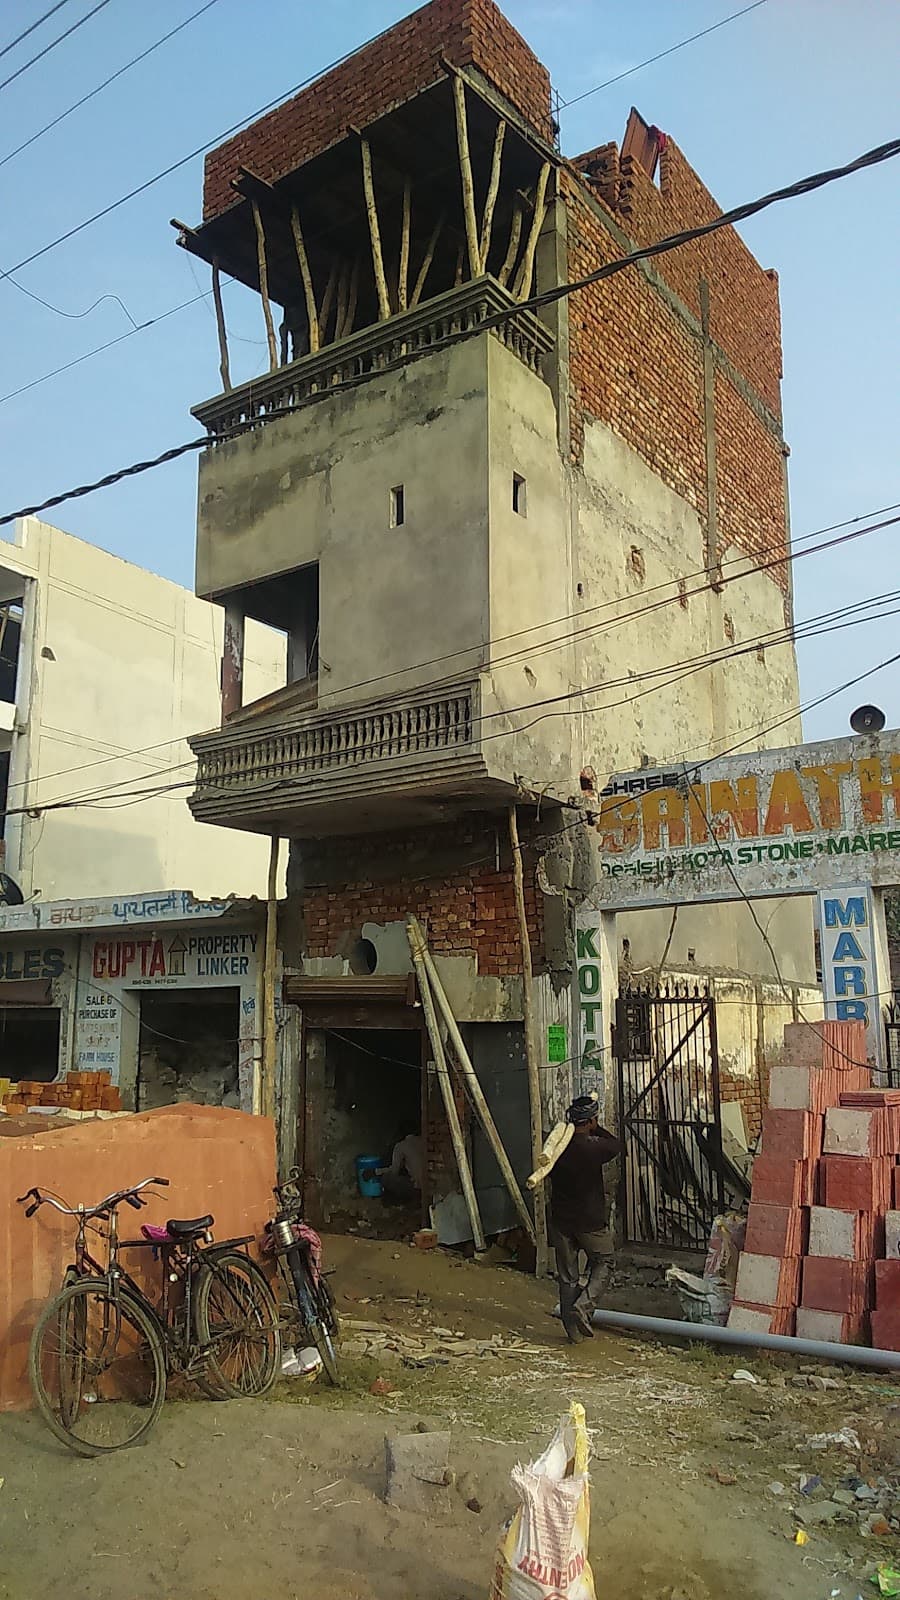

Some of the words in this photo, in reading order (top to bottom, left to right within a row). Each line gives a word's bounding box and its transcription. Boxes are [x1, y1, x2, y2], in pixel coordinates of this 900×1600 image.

[600, 772, 679, 797] SHREE
[93, 938, 166, 978] GUPTA
[188, 933, 258, 955] PROPERTY
[198, 956, 249, 976] LINKER
[86, 995, 105, 1006] SALE
[576, 927, 603, 1071] KOTA
[79, 1009, 108, 1019] PURCHASE
[109, 1009, 117, 1018] OF
